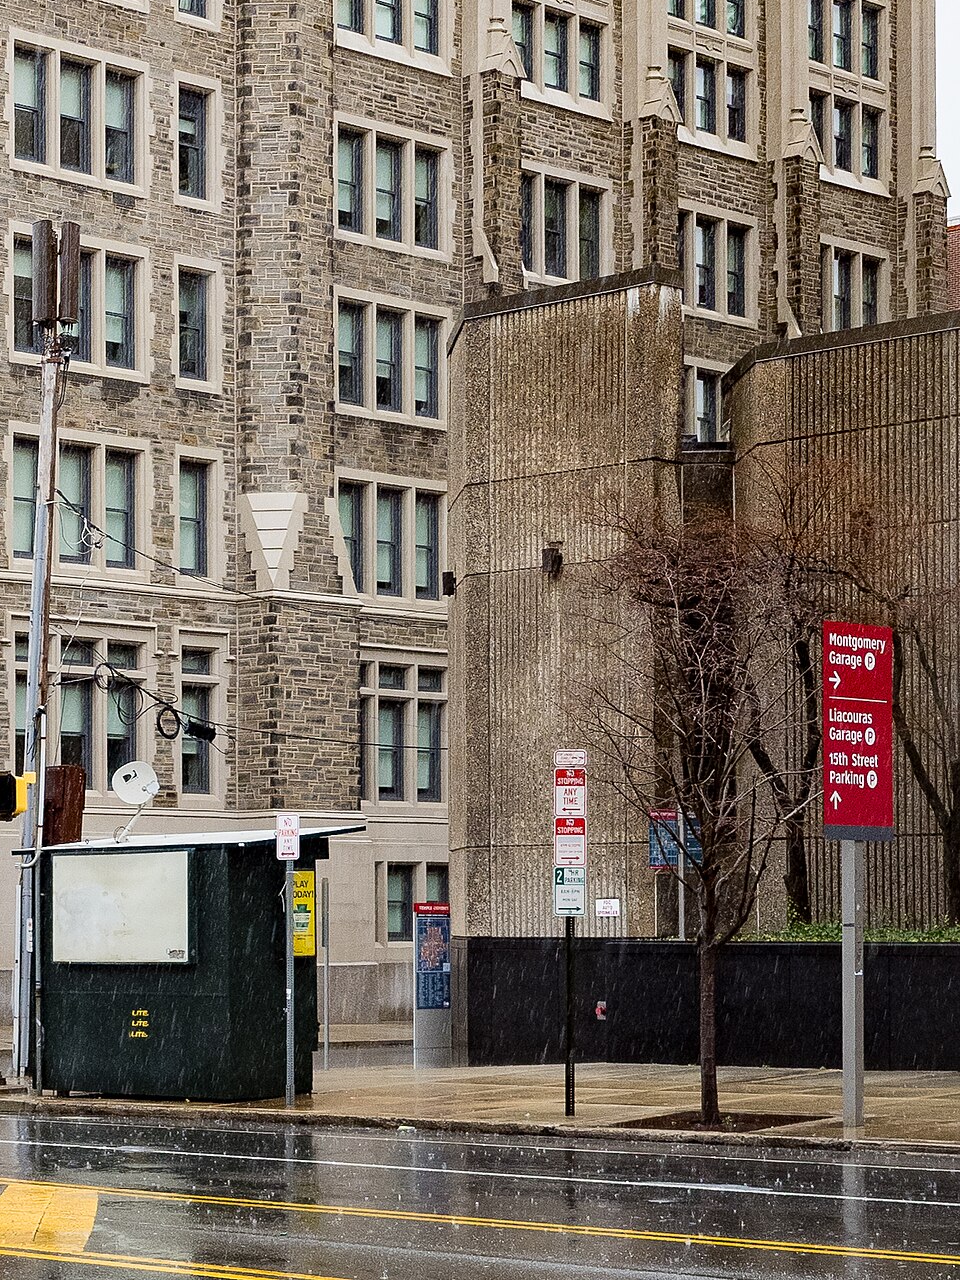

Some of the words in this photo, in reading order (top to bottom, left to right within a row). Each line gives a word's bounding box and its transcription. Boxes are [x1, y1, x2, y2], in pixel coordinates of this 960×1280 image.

[829, 632, 886, 654] Montgomery
[829, 650, 862, 670] Garage
[829, 707, 873, 725] Liacouras
[829, 726, 863, 745] Garage
[829, 751, 849, 766] 15th
[851, 753, 878, 768] Street
[557, 777, 584, 785] STOPPING
[829, 769, 865, 789] Parking
[563, 788, 578, 796] ANY
[563, 797, 578, 805] TIME
[557, 826, 584, 834] STOPPING
[556, 870, 563, 883] 2
